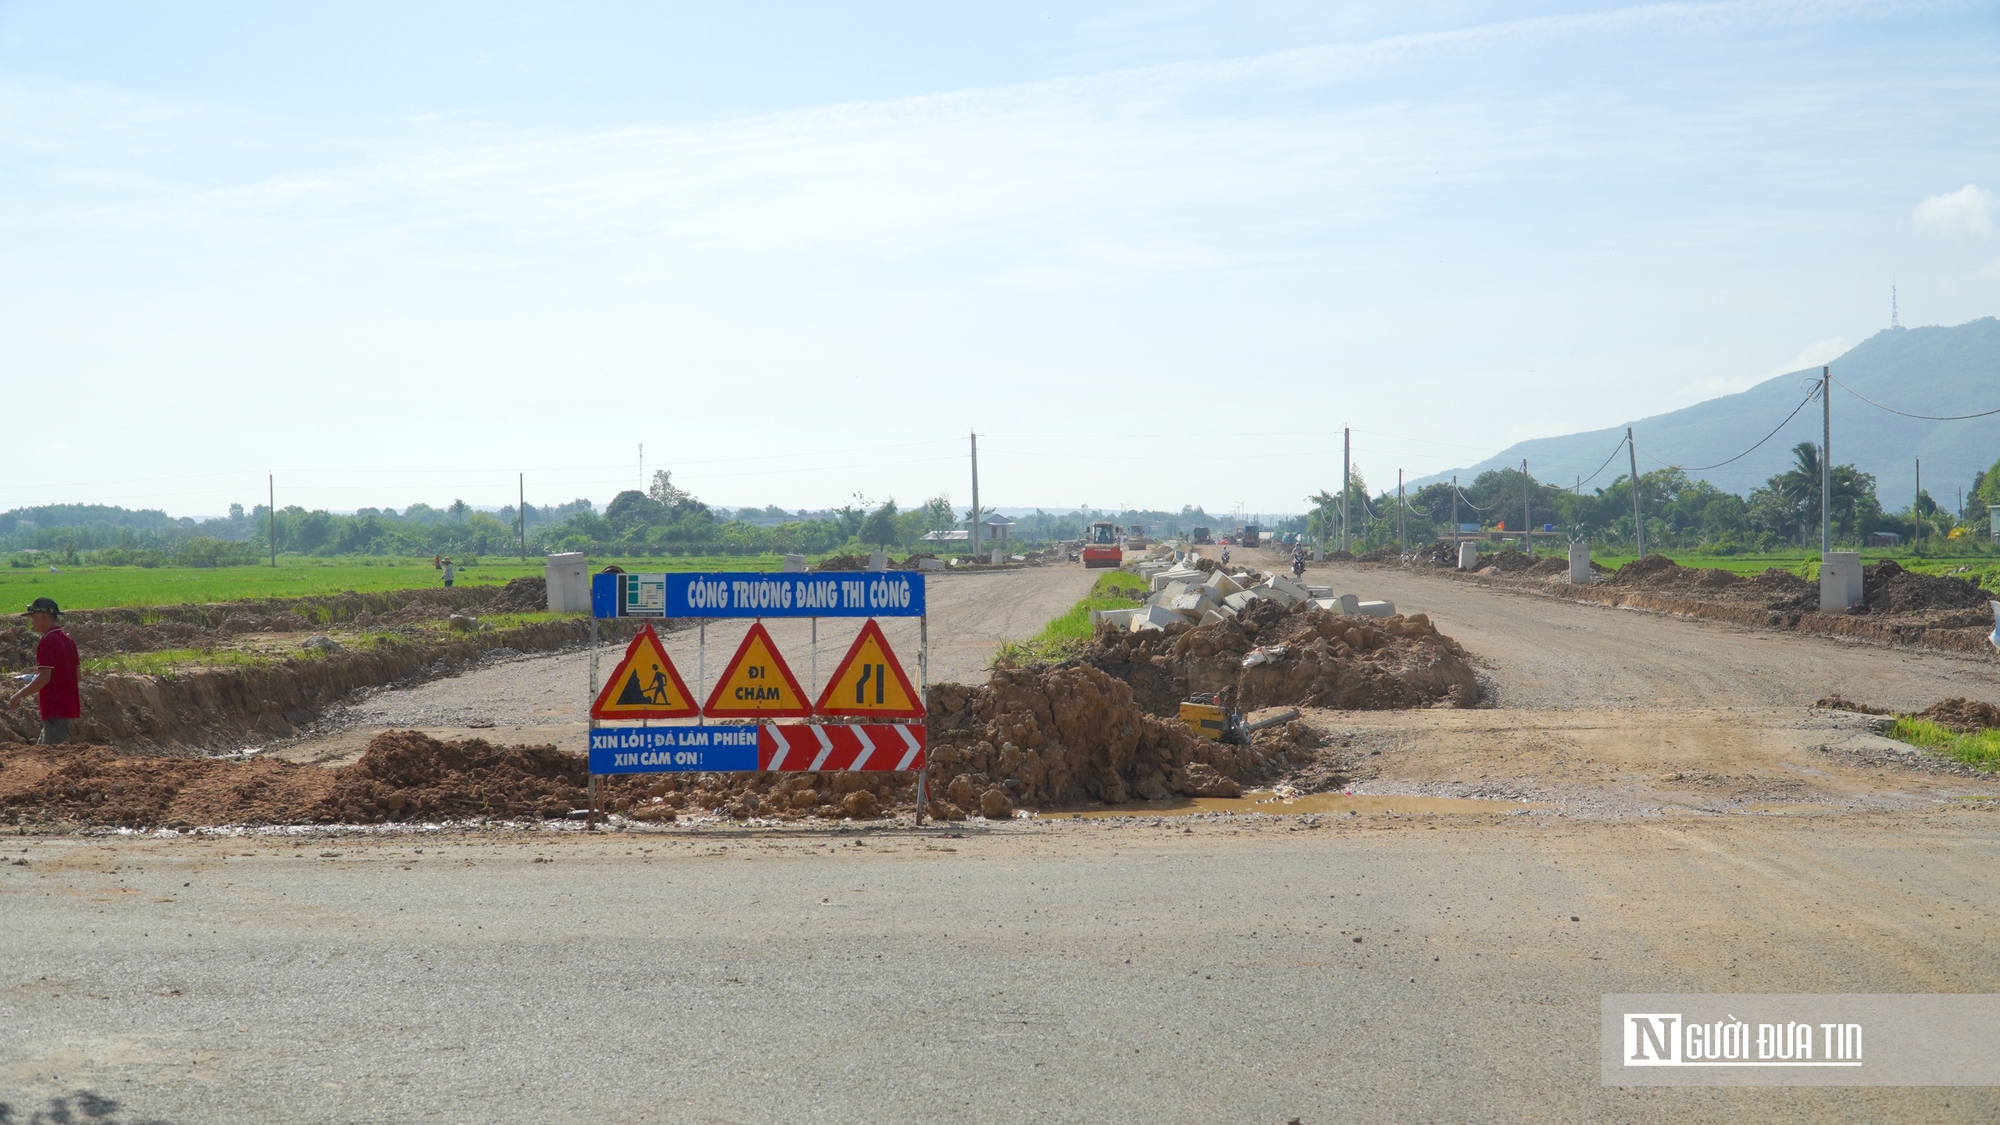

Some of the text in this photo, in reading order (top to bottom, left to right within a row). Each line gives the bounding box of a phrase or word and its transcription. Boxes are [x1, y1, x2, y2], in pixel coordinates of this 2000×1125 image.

[687, 575, 911, 609] CÔNG TRƯỜNG ĐANG THI CÔNG
[748, 666, 765, 679] ĐI
[735, 685, 780, 704] CHẬM
[592, 735, 618, 749] XIN
[654, 730, 676, 747] ĐÃ
[679, 730, 709, 746] LÀM
[713, 728, 757, 746] PHIỀN
[614, 753, 638, 766] XIN
[640, 748, 671, 766] CẢM
